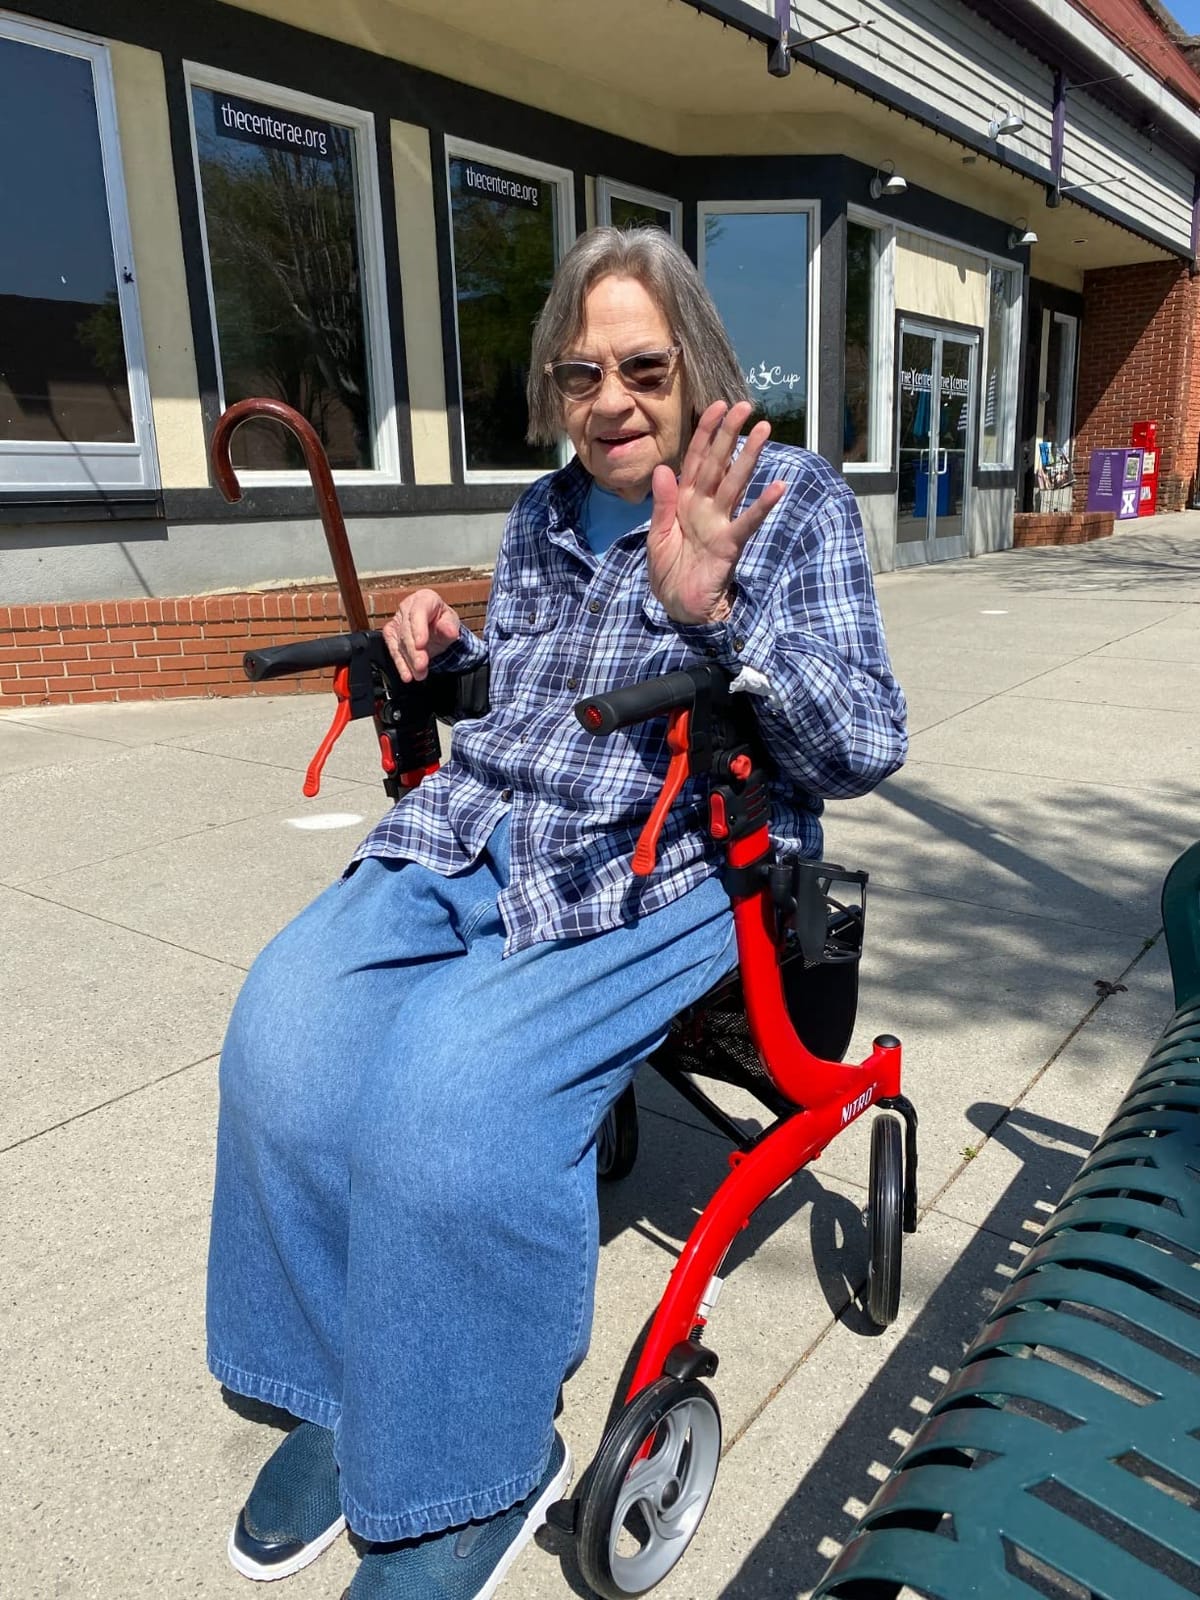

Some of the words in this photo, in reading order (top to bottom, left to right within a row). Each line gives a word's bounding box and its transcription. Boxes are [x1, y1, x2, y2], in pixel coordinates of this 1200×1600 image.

[221, 102, 328, 155] thecenterae.org
[466, 166, 538, 207] thecenterae.org
[769, 366, 800, 390] Cup
[840, 1087, 873, 1127] NITRO
